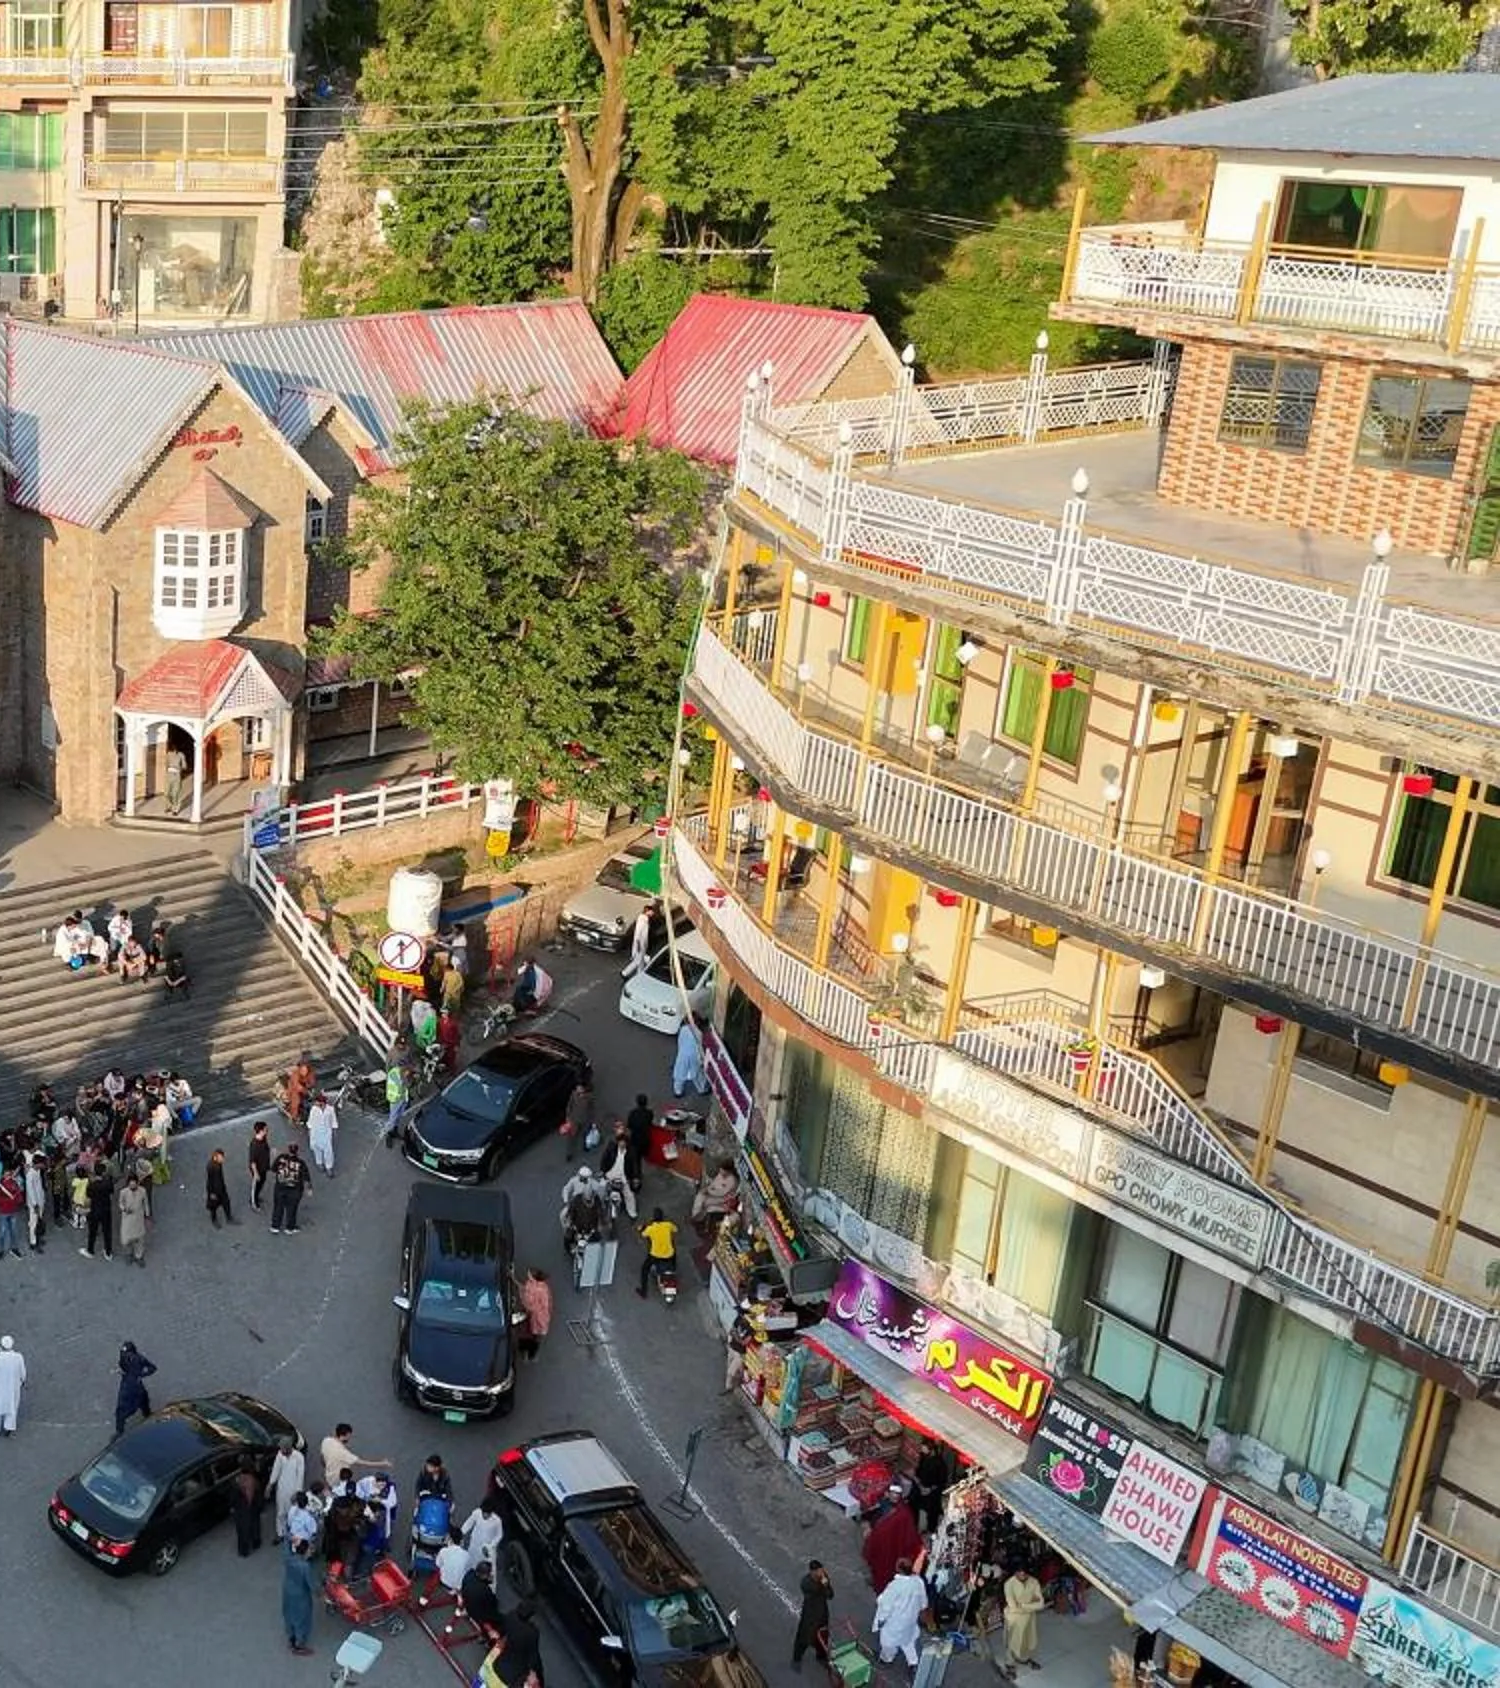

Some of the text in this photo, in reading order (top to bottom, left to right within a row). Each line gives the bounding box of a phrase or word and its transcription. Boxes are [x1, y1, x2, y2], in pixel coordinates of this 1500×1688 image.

[1095, 1165, 1257, 1256] GPO CHOWK MURREE
[1100, 1140, 1262, 1233] FAMILY ROOMS
[1049, 1400, 1087, 1432] PINK
[1117, 1476, 1186, 1530] SHAWL
[1126, 1451, 1197, 1503] AHMED
[1110, 1500, 1177, 1553] HOUSE
[1229, 1507, 1362, 1589] ABDULLAH NOVELTIES
[1378, 1621, 1439, 1671] TAREEN
